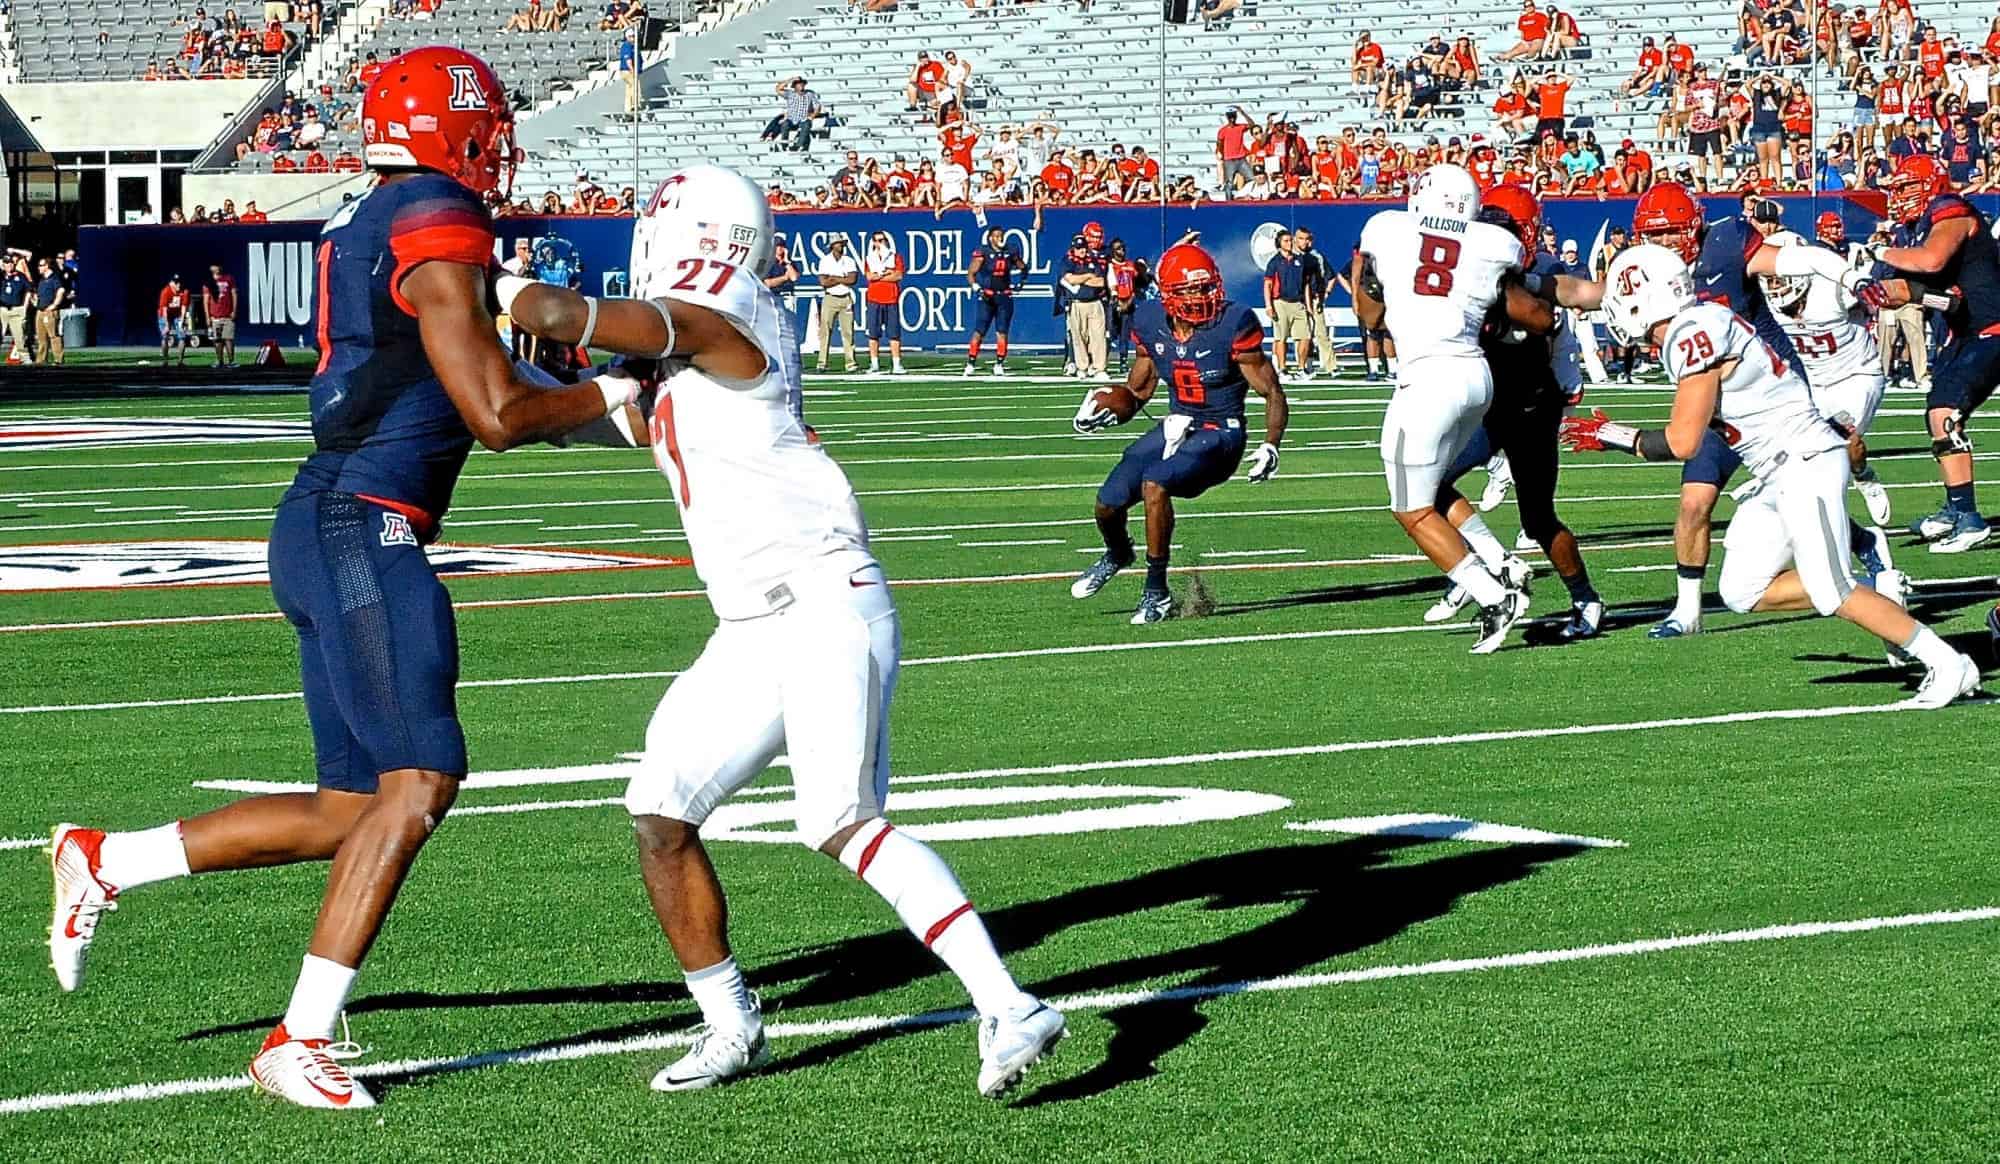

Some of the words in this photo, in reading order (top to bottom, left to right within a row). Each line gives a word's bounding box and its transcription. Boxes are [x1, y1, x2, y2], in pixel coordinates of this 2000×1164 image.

[448, 65, 489, 111] A
[1419, 216, 1468, 234] ALLISON
[772, 231, 897, 275] ASNO
[905, 230, 969, 275] DEL
[982, 229, 1051, 275] OL
[1413, 231, 1462, 297] 8
[670, 257, 737, 296] 27
[1679, 330, 1715, 368] 29
[379, 511, 419, 547] A
